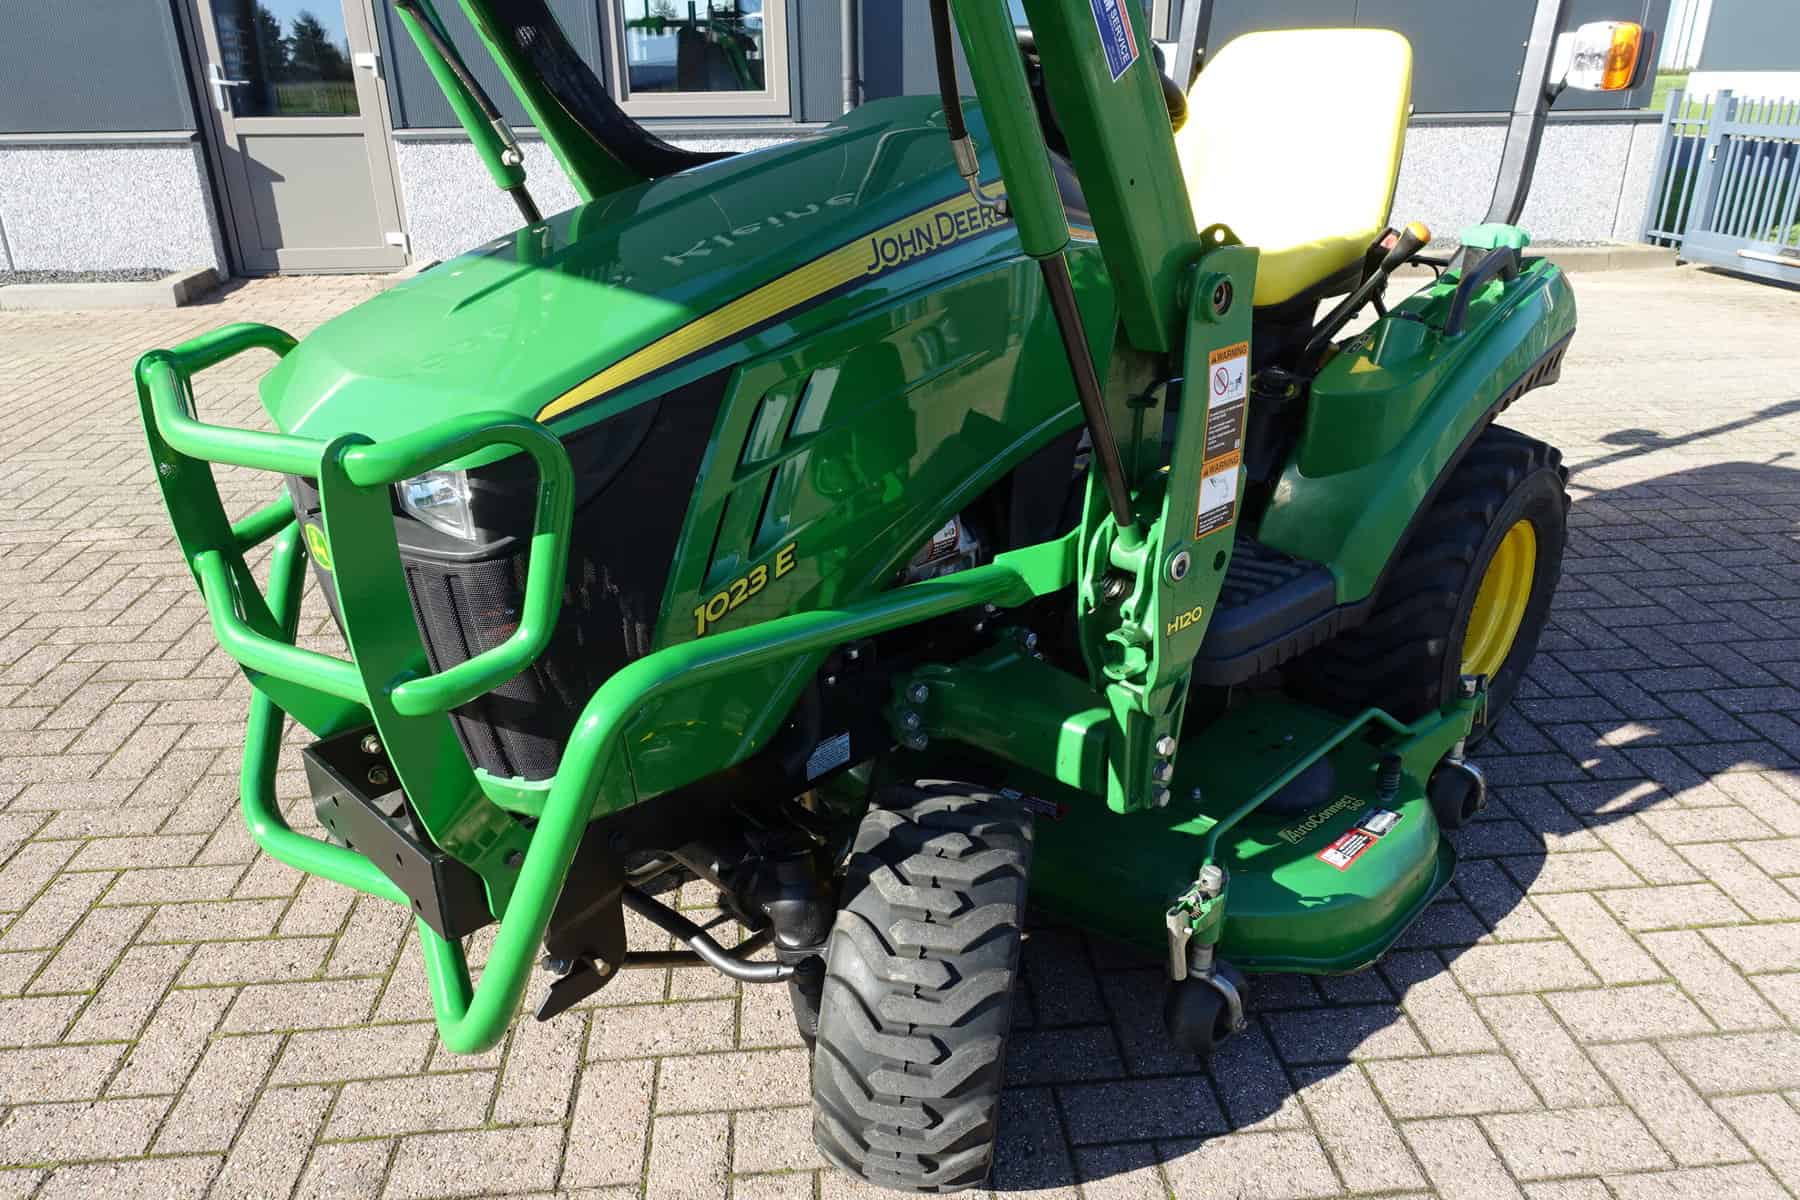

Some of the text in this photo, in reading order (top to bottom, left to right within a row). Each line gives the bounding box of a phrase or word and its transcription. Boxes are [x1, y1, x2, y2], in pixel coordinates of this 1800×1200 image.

[1110, 8, 1130, 65] SERVICE
[867, 223, 933, 272] JOHN
[1216, 343, 1248, 360] WARNING
[694, 542, 796, 636] 1023 E
[1166, 606, 1202, 636] H120
[1286, 793, 1356, 842] AutoConnect
